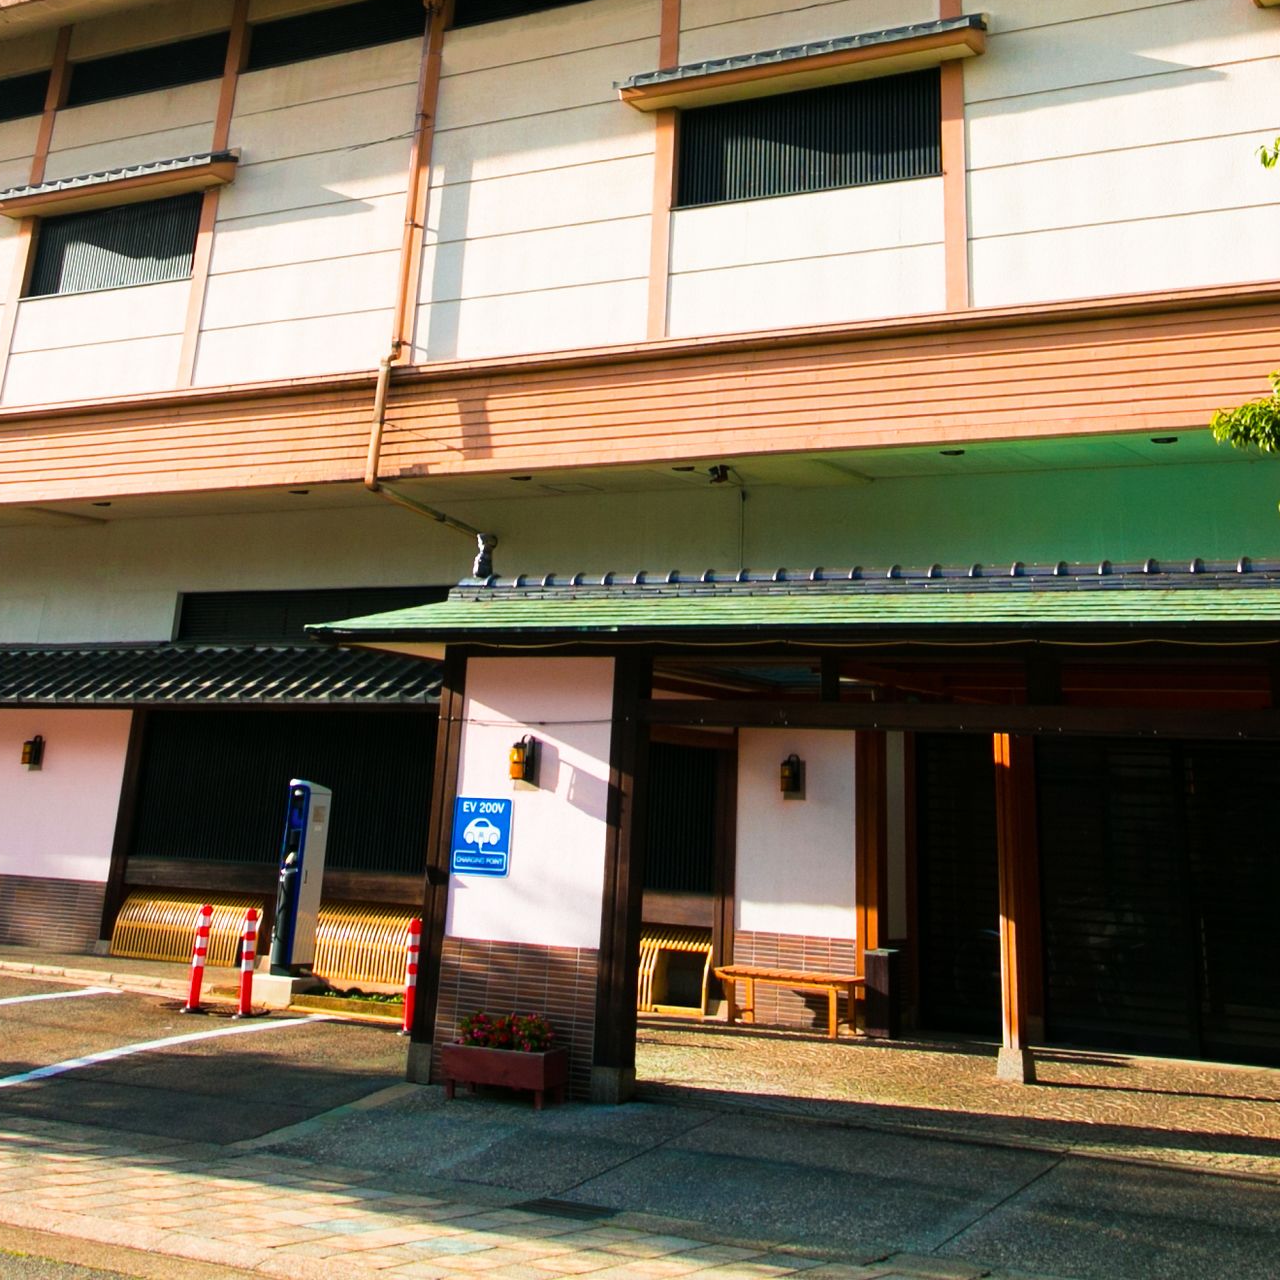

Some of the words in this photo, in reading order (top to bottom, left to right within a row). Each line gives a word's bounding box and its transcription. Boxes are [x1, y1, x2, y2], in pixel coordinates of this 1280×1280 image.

[463, 801, 477, 813] EV
[479, 802, 505, 814] 200V
[456, 855, 485, 864] CHARGING
[486, 857, 503, 865] POINT
